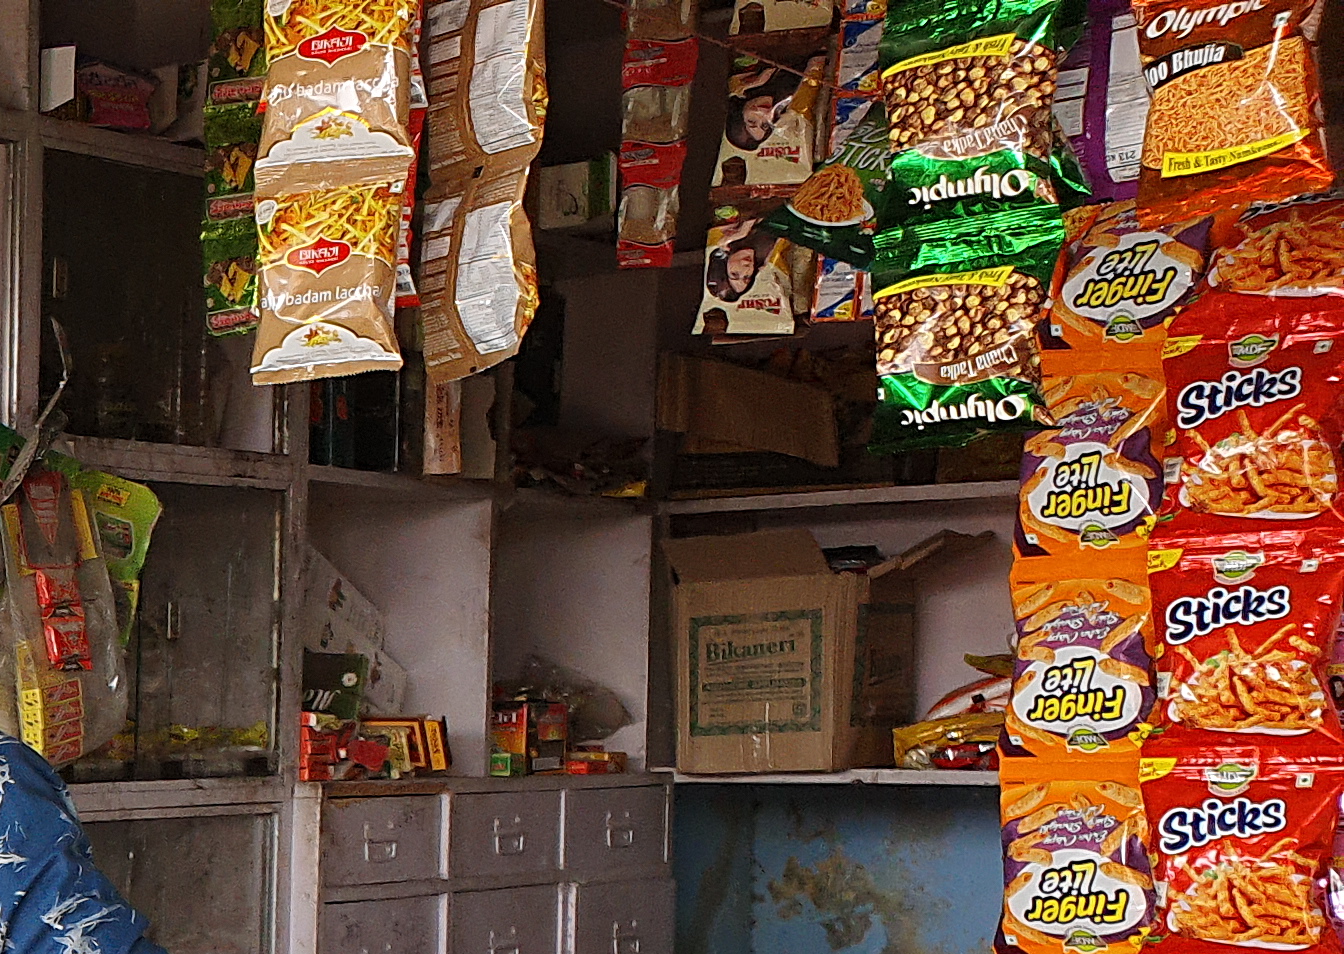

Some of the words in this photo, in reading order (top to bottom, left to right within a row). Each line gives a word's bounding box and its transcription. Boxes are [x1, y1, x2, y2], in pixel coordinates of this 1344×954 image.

[311, 36, 354, 51] BIKAJI
[1172, 43, 1225, 75] Bhujia
[943, 129, 985, 155] Tadka
[1168, 156, 1191, 173] Fresh
[908, 165, 1031, 210] Olympic
[299, 246, 339, 260] BIKAJI
[1096, 239, 1160, 278] Lite
[285, 289, 332, 305] badam
[1073, 266, 1178, 310] Finger
[940, 358, 976, 381] Tadka
[976, 344, 1019, 370] Chana
[900, 393, 1025, 431] Olympic
[1179, 368, 1301, 427] Sticks
[1052, 450, 1103, 491] Lite
[1039, 478, 1133, 519] Finger
[1167, 587, 1290, 643] Sticks
[1041, 655, 1096, 694] Lite
[1027, 685, 1126, 723] Finger
[1160, 800, 1285, 853] Sticks
[1040, 859, 1096, 896] Lite
[1025, 889, 1128, 924] Finger
